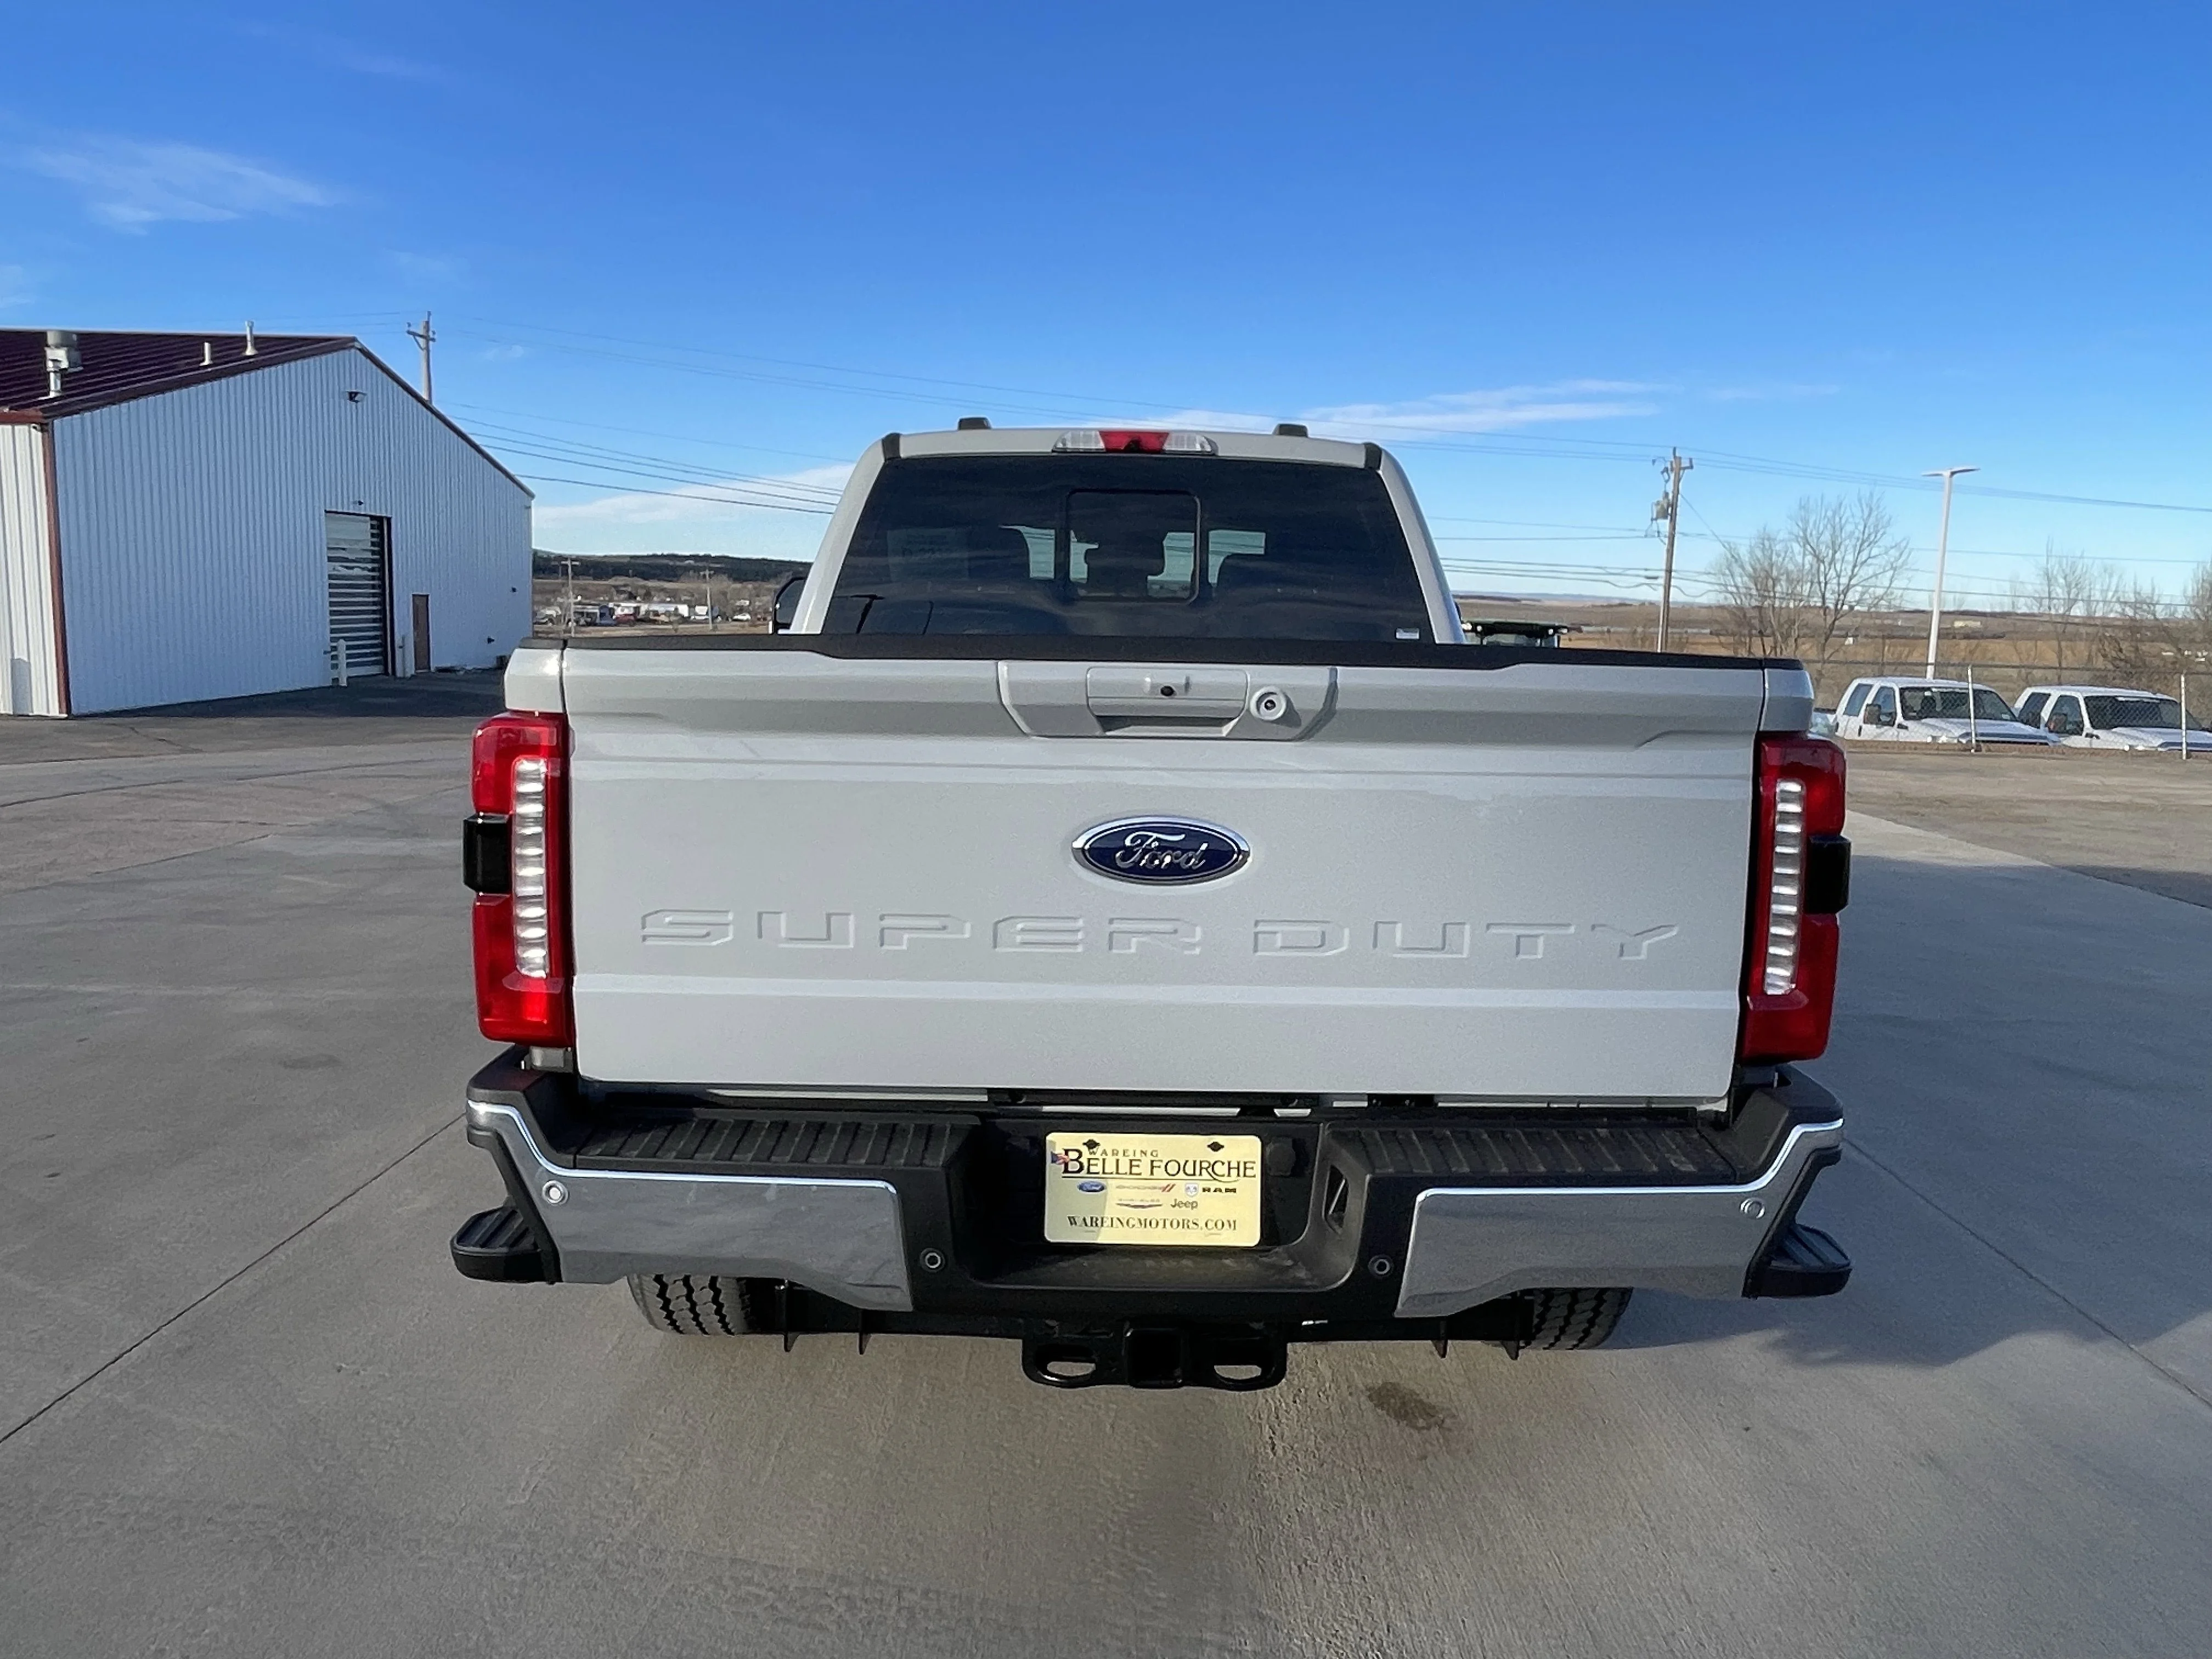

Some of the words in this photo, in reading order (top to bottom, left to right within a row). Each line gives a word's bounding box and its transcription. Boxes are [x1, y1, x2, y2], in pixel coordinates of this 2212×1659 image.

[1115, 831, 1209, 870] Ford
[641, 908, 1202, 956] SUPER
[1252, 919, 1680, 961] DUTY
[1062, 1148, 1142, 1176] BELLE
[1150, 1158, 1256, 1183] FOURCHE
[1088, 1147, 1159, 1158] WAREING
[1170, 1198, 1199, 1210] Jeep
[1068, 1215, 1237, 1232] WAREINGMOTORS.COM
